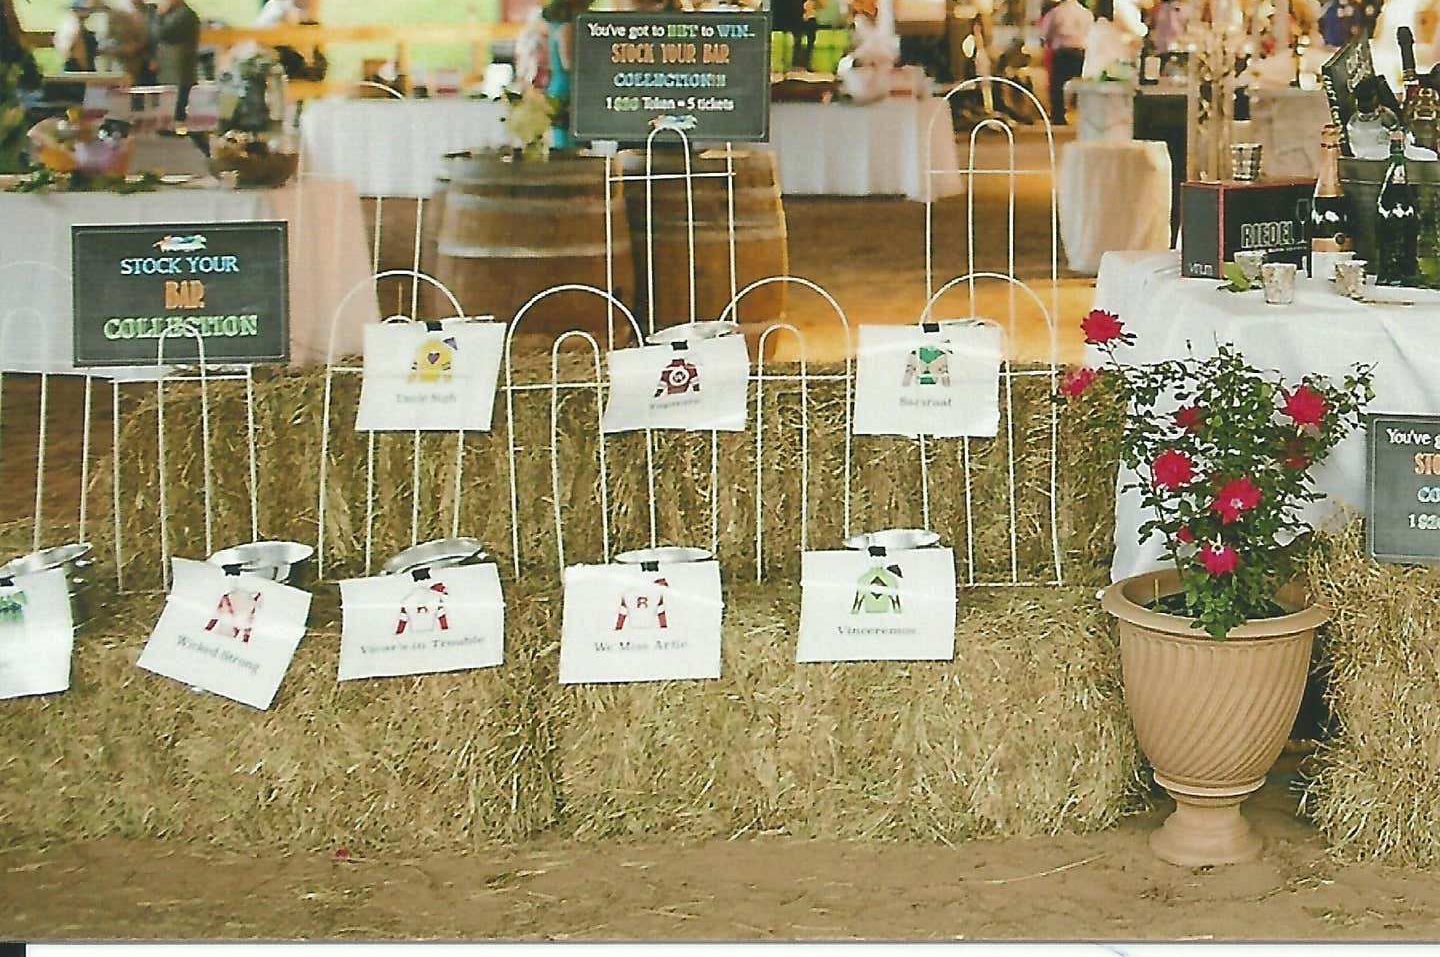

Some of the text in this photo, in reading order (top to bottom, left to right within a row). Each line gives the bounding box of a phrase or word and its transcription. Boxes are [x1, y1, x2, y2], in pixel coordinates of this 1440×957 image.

[587, 22, 626, 38] You've
[629, 24, 650, 40] got
[652, 24, 665, 37] to
[701, 24, 714, 37] to
[611, 43, 730, 64] STOCK YOUR BAR
[641, 97, 676, 110] Token
[687, 97, 696, 110] 5
[697, 97, 735, 110] tickets
[1240, 221, 1295, 249] RIEDEL
[120, 255, 240, 276] STOCK YOUR
[164, 279, 205, 310] BAR
[103, 314, 259, 340] COLLECTION
[1385, 428, 1432, 447] You've
